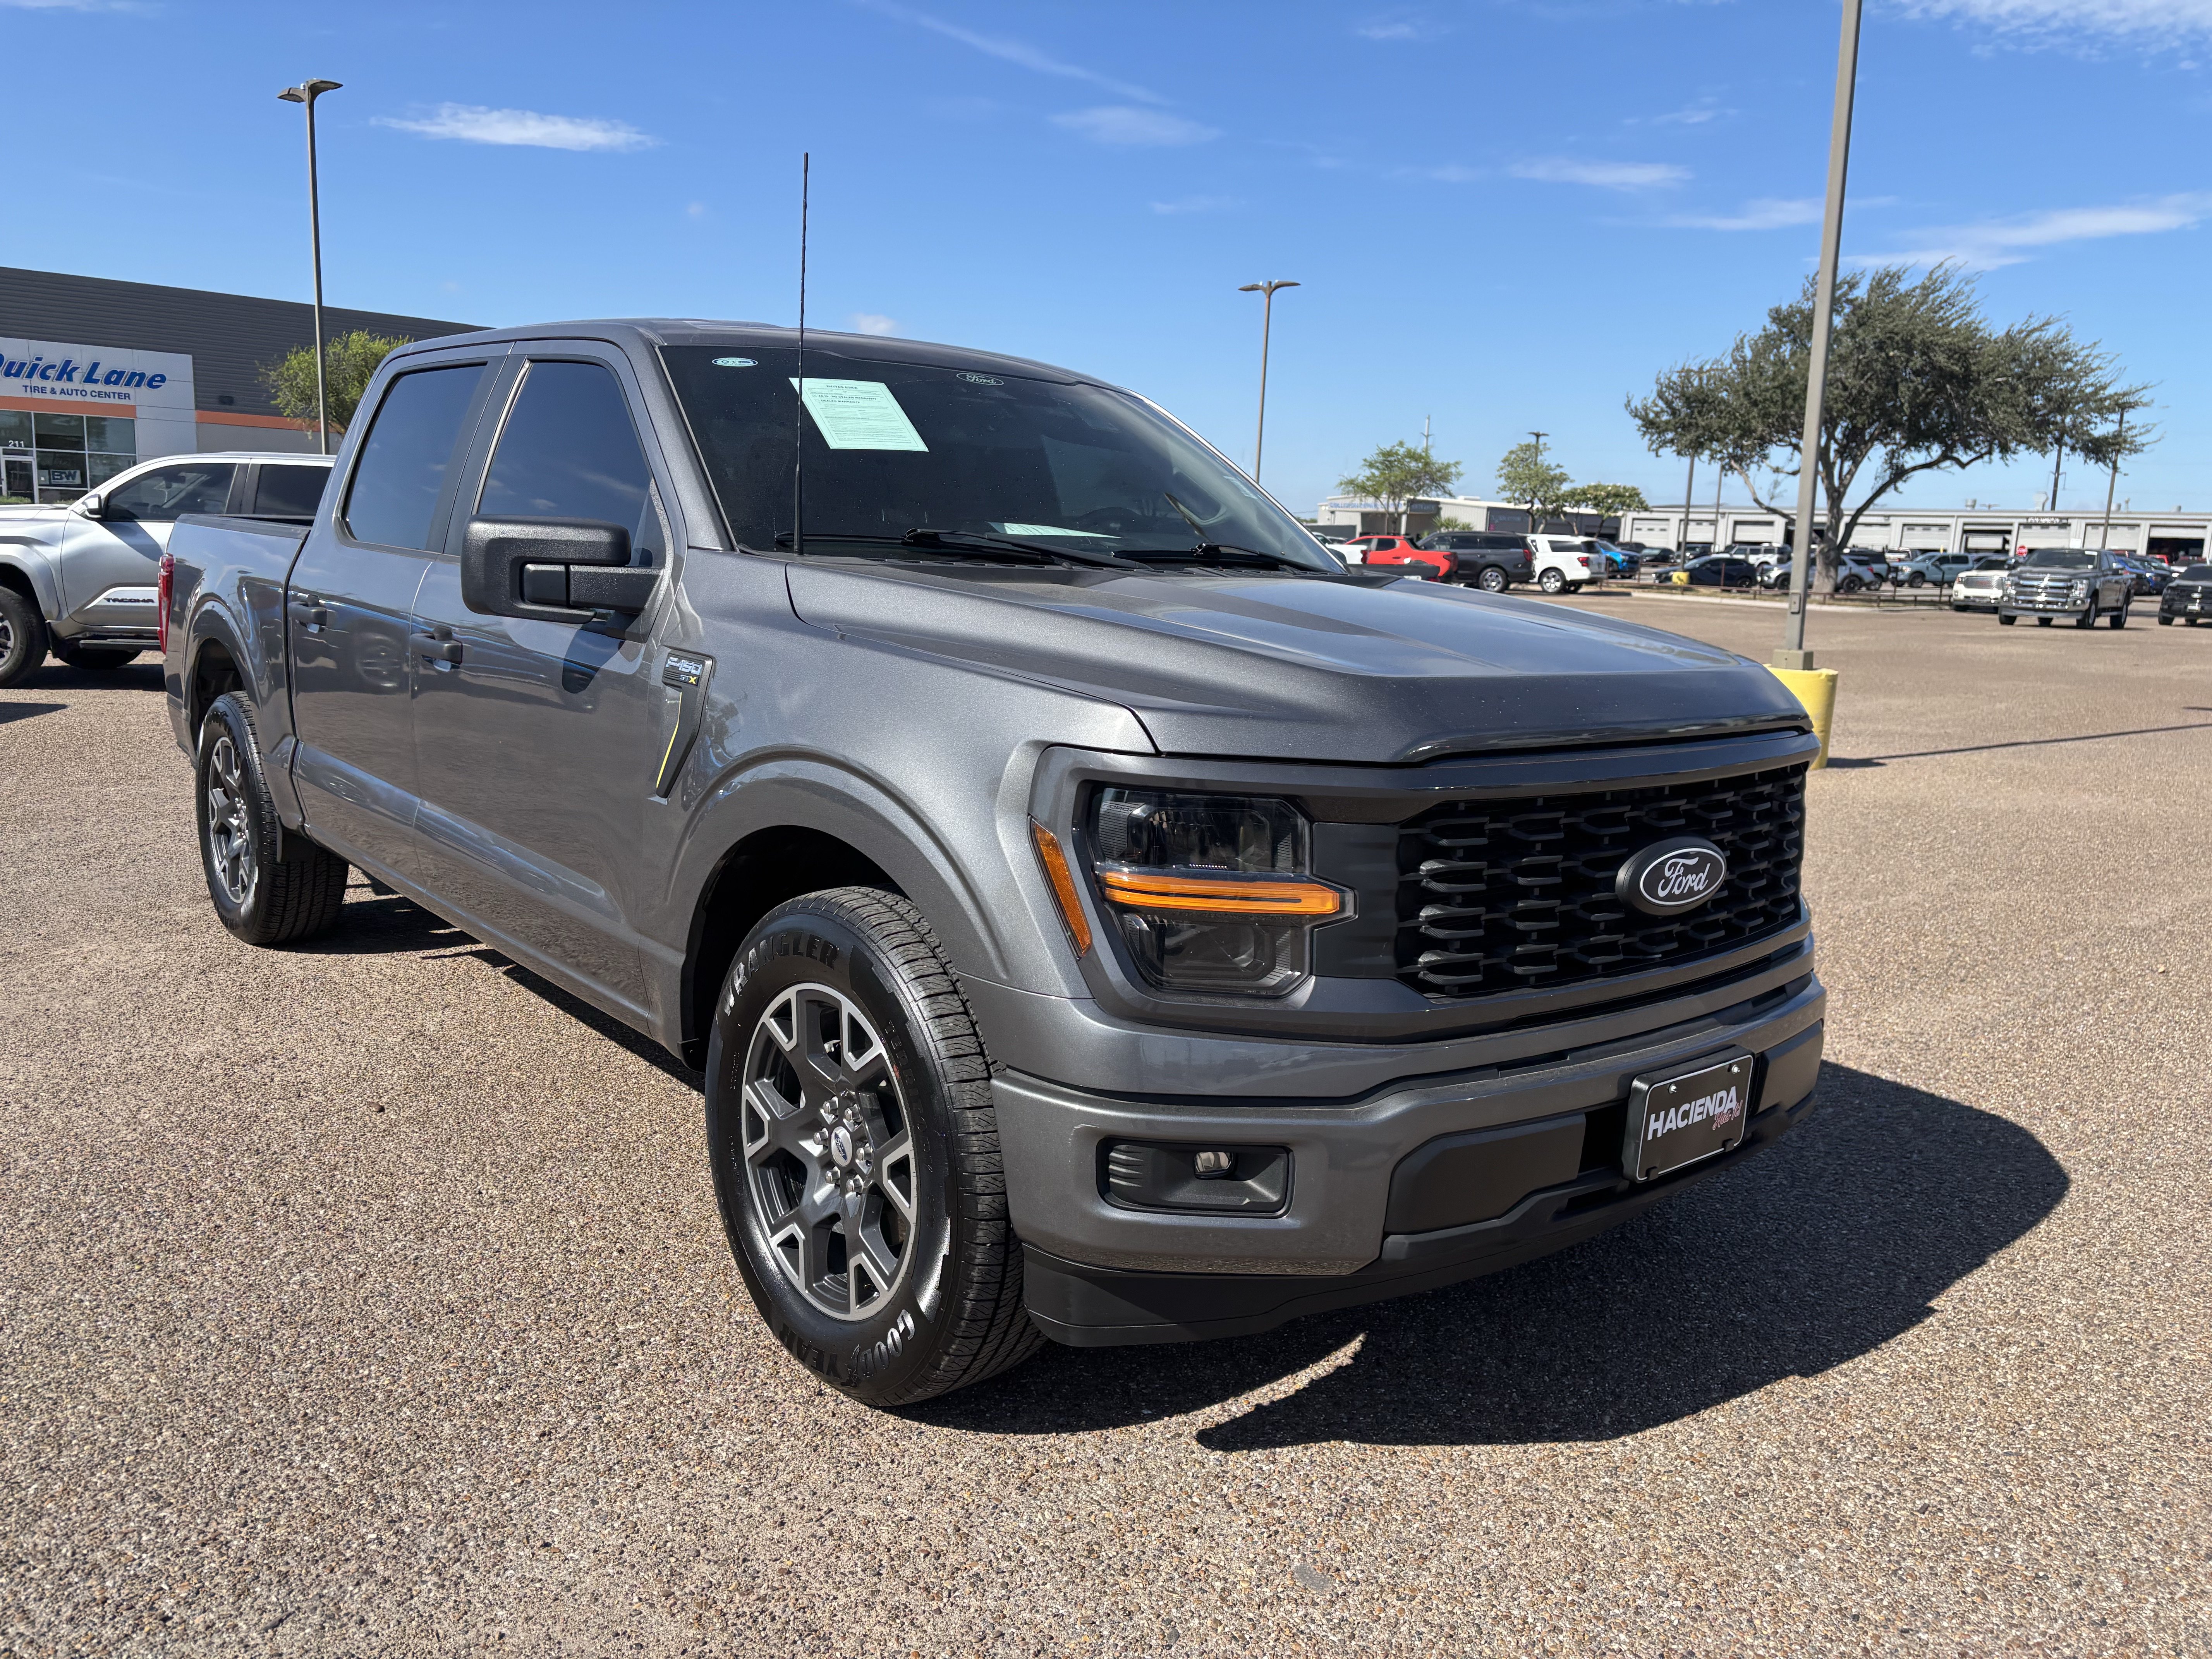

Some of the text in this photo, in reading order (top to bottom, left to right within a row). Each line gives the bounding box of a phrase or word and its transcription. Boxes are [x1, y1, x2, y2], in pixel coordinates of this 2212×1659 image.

[83, 362, 167, 389] Lane
[966, 374, 996, 384] Ford
[22, 385, 47, 394] TIRE
[59, 388, 88, 397] AUTO
[90, 390, 131, 400] CENTER
[665, 656, 702, 675] F-150
[679, 674, 697, 684] STX
[1658, 857, 1711, 897] Ford
[722, 930, 839, 1017] WRANGLER
[1647, 1086, 1737, 1141] HACIENDA
[835, 1138, 845, 1157] Ford
